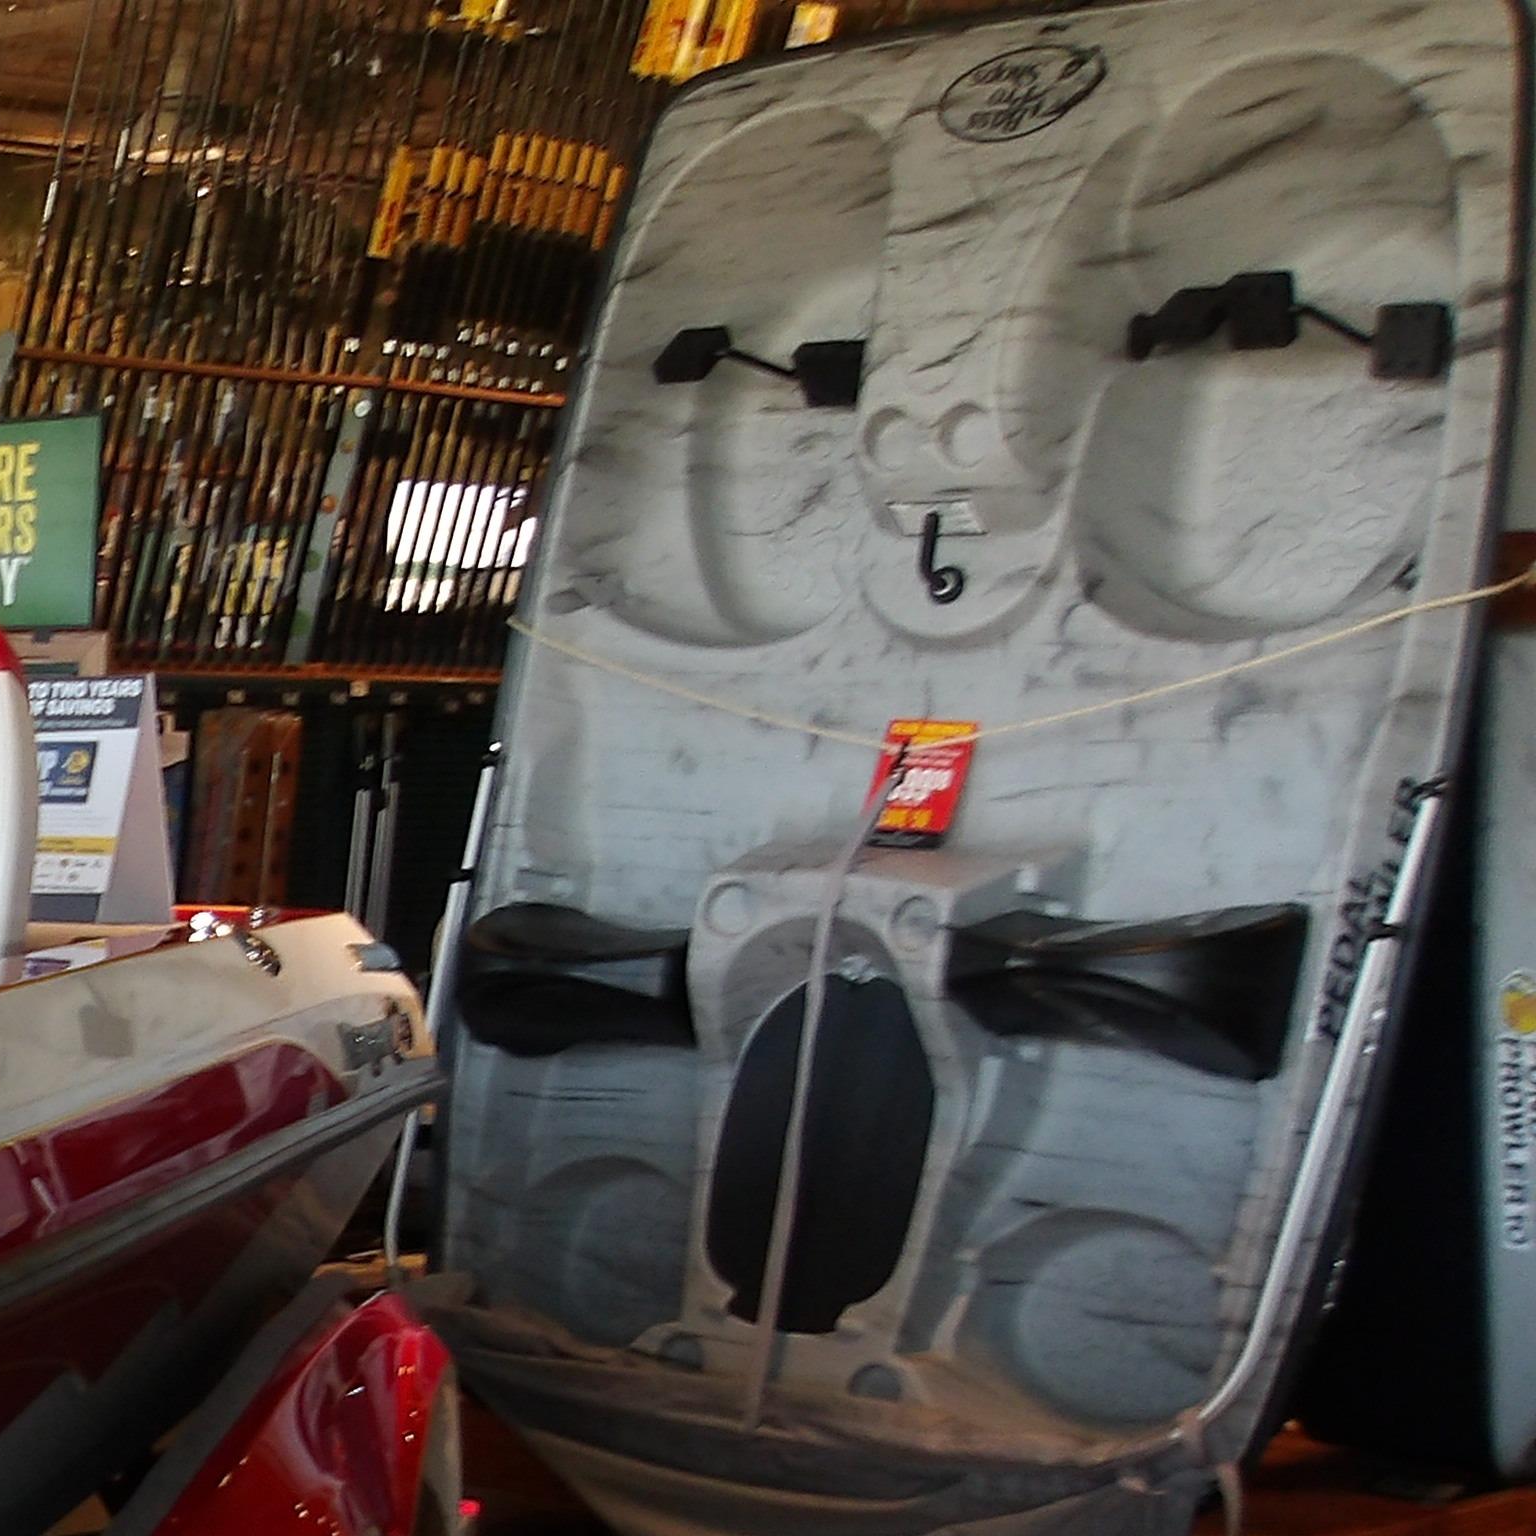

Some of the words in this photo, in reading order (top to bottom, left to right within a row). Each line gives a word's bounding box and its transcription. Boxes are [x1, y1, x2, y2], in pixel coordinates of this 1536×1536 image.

[28, 681, 50, 699] TO
[51, 680, 88, 698] TWO
[89, 678, 144, 698] YEARS
[45, 698, 116, 716] SAVINGS
